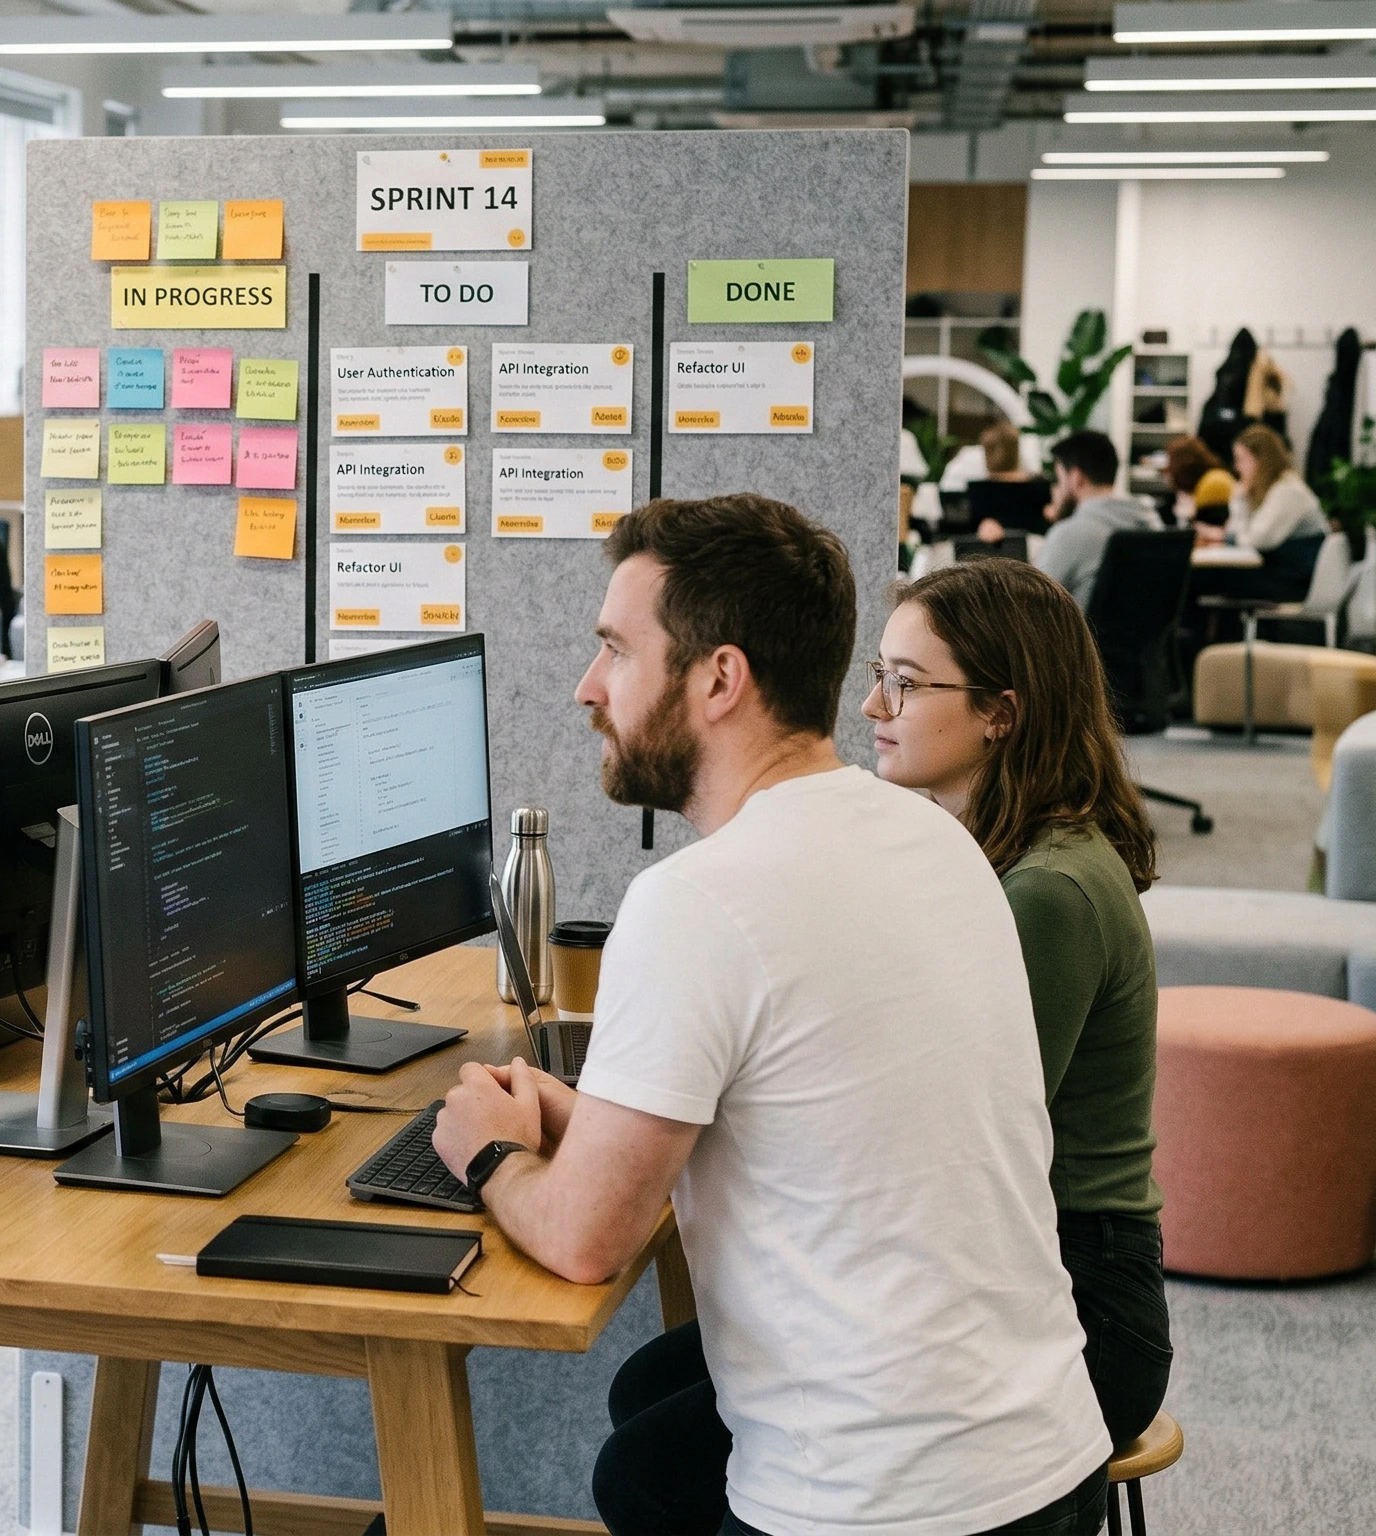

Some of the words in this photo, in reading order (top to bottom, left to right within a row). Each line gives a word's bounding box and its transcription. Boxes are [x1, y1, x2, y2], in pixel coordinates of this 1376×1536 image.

[370, 186, 474, 211] SPRINT
[484, 186, 518, 210] 14
[124, 288, 146, 306] IN
[155, 286, 273, 306] PROGRESS
[419, 284, 451, 303] TO
[459, 284, 494, 303] DO
[726, 282, 796, 302] DONE
[337, 367, 365, 379] User
[367, 366, 455, 379] Authentication
[498, 362, 519, 374] API
[523, 362, 589, 377] Integration
[677, 360, 728, 374] Refactor
[731, 362, 745, 374] UI
[336, 463, 356, 475] API
[360, 463, 425, 478] Integration
[499, 467, 518, 479] API
[522, 467, 584, 481] Integration
[337, 561, 386, 573] Refactor
[389, 562, 402, 573] UI
[28, 731, 51, 747] DELL
